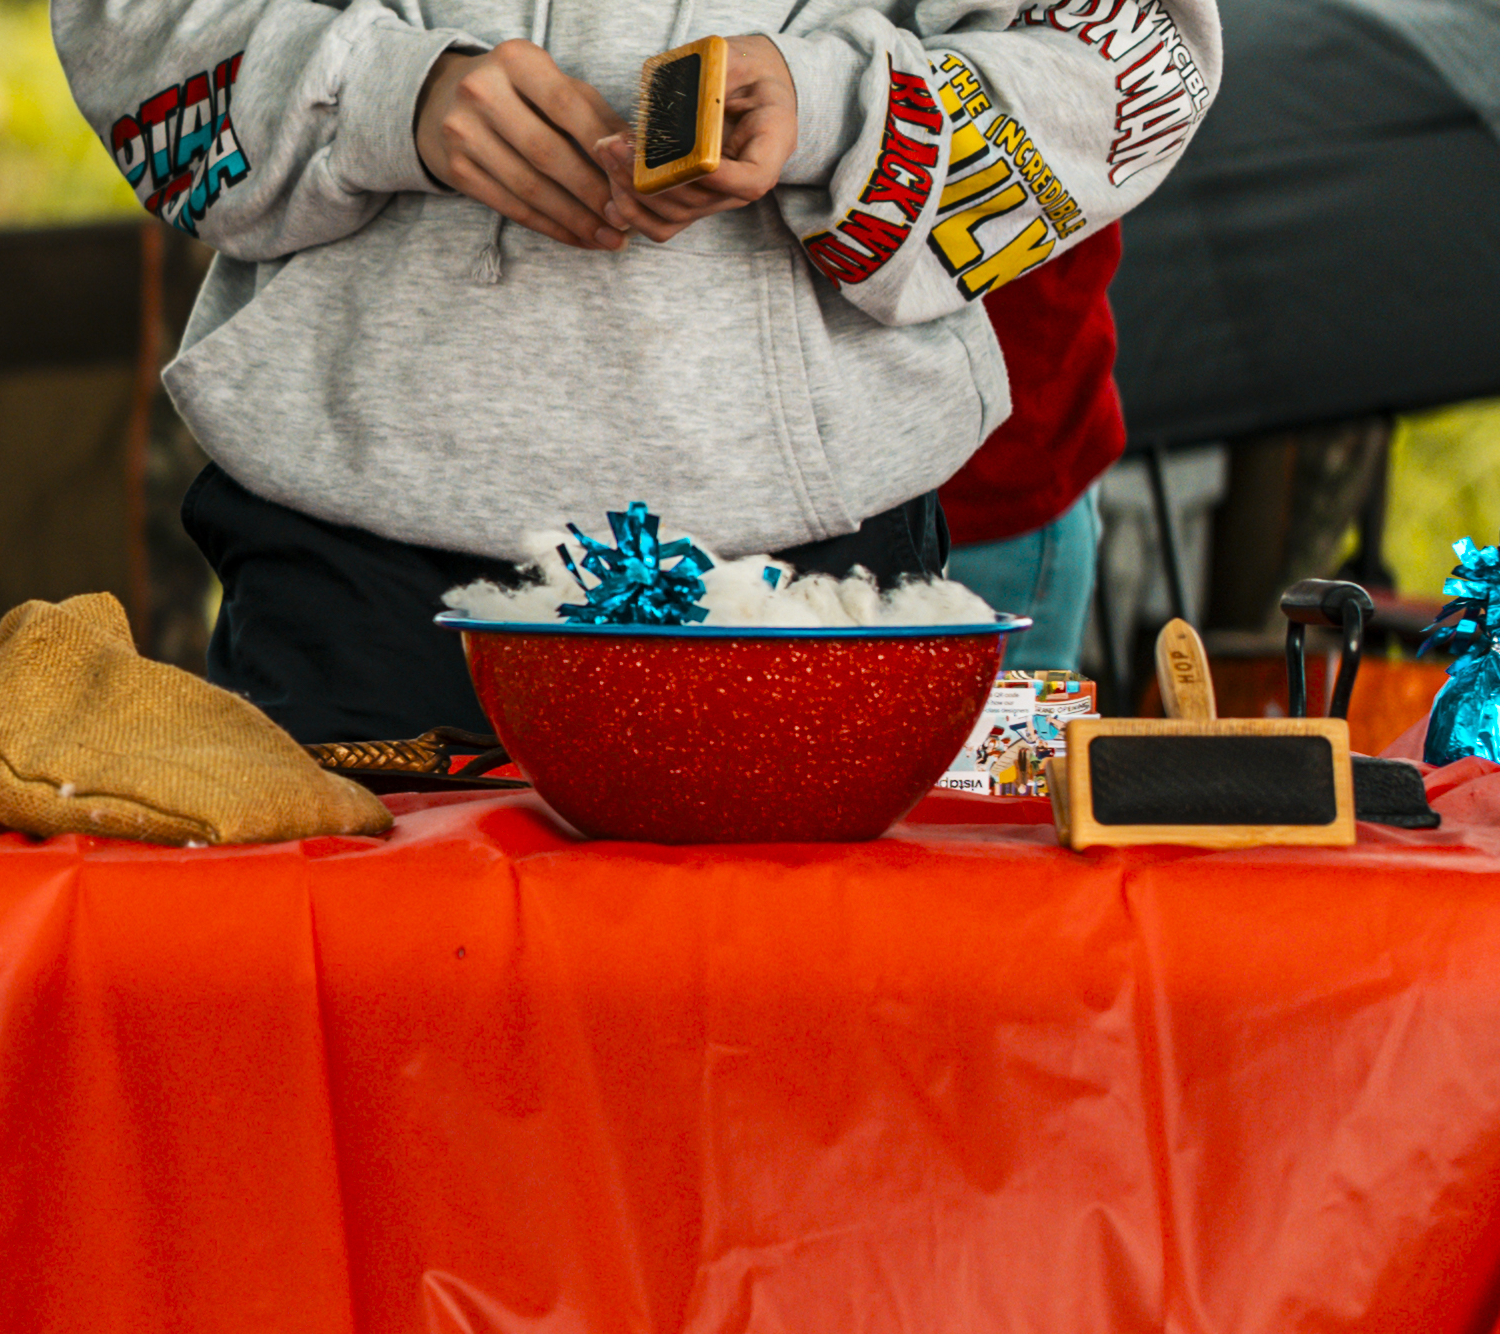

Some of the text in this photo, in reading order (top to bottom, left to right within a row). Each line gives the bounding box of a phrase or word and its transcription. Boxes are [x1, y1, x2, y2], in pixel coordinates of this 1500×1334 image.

[938, 53, 1088, 241] THE INCREDIBLE
[1113, 39, 1197, 189] MAN
